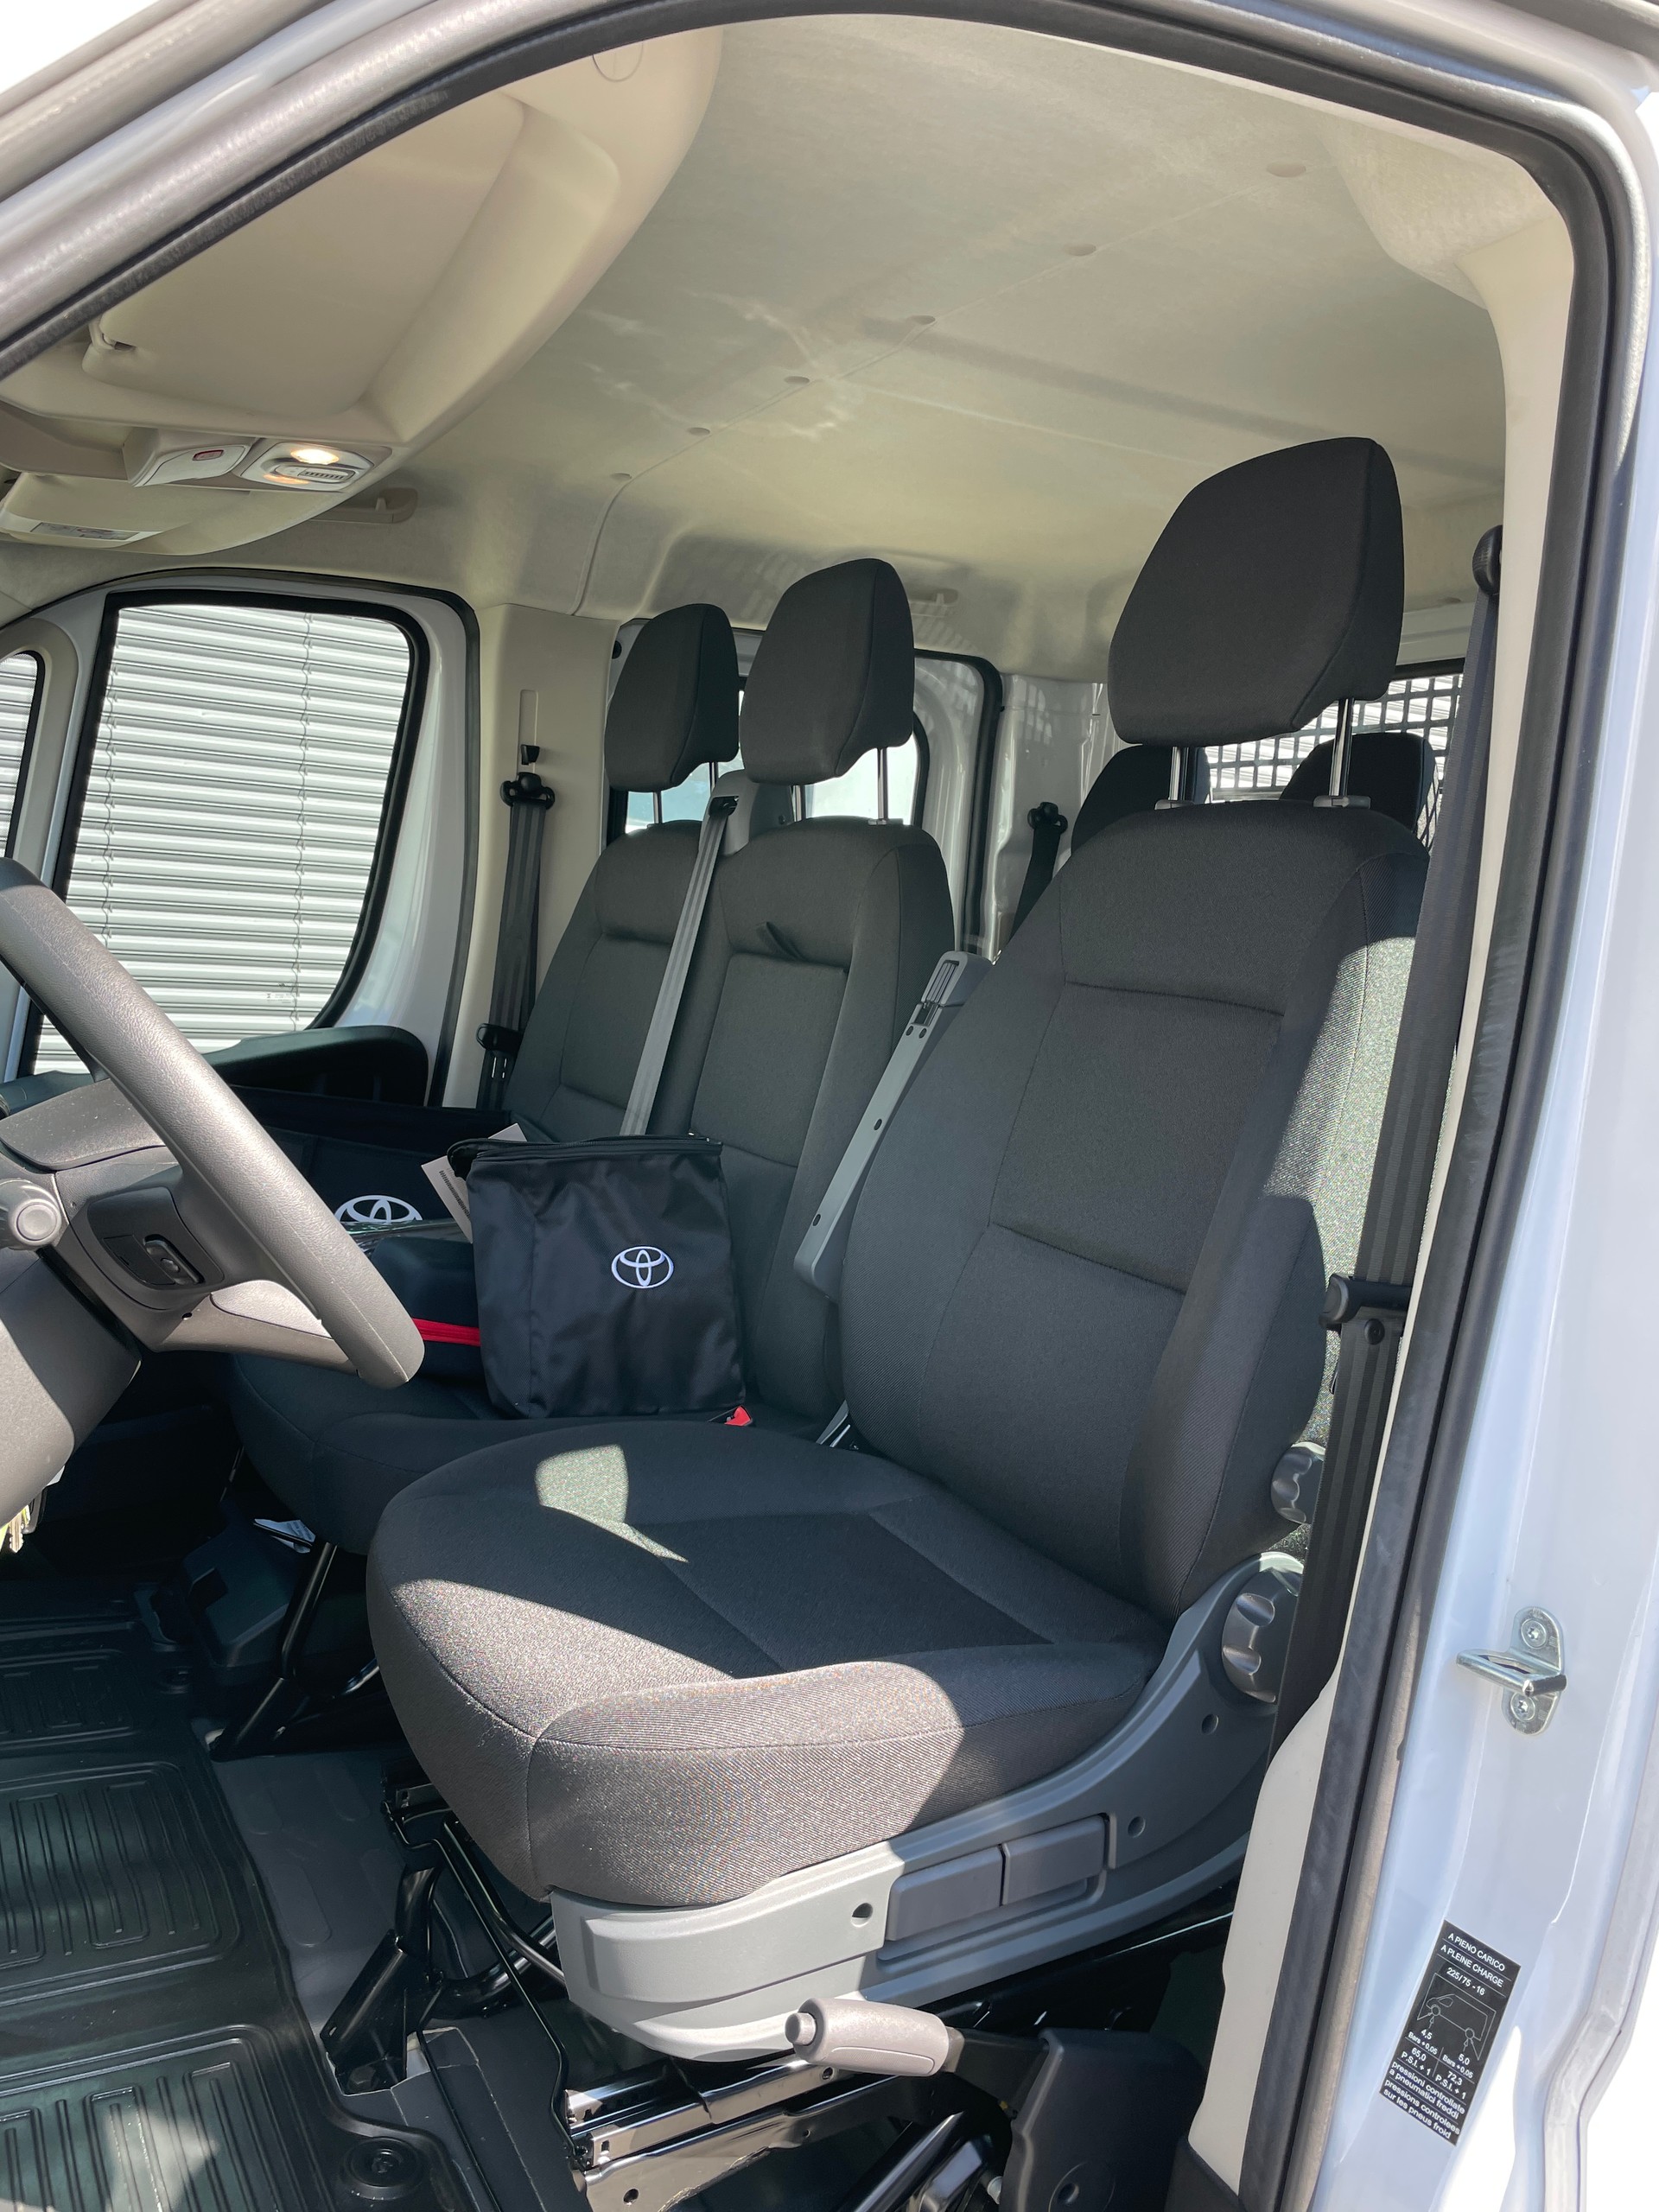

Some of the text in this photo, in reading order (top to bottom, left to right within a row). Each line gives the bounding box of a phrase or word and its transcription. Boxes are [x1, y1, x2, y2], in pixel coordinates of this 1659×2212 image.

[1454, 1936, 1477, 1954] PIENO
[1478, 1950, 1505, 1971] CARICO
[1447, 1948, 1472, 1967] PLEINE
[1472, 1964, 1503, 1987] CHARGE
[1477, 1986, 1484, 1995] 16
[1421, 2029, 1432, 2039] 4,5
[1412, 2048, 1426, 2061] 65,0
[1459, 2054, 1470, 2065] 5,0
[1392, 2062, 1425, 2087] pressioni
[1447, 2071, 1462, 2085] 72,3
[1384, 2080, 1420, 2107] pressions
[1383, 2089, 1451, 2139] sur les pneus froid
[1436, 2100, 1459, 2119] freddi
